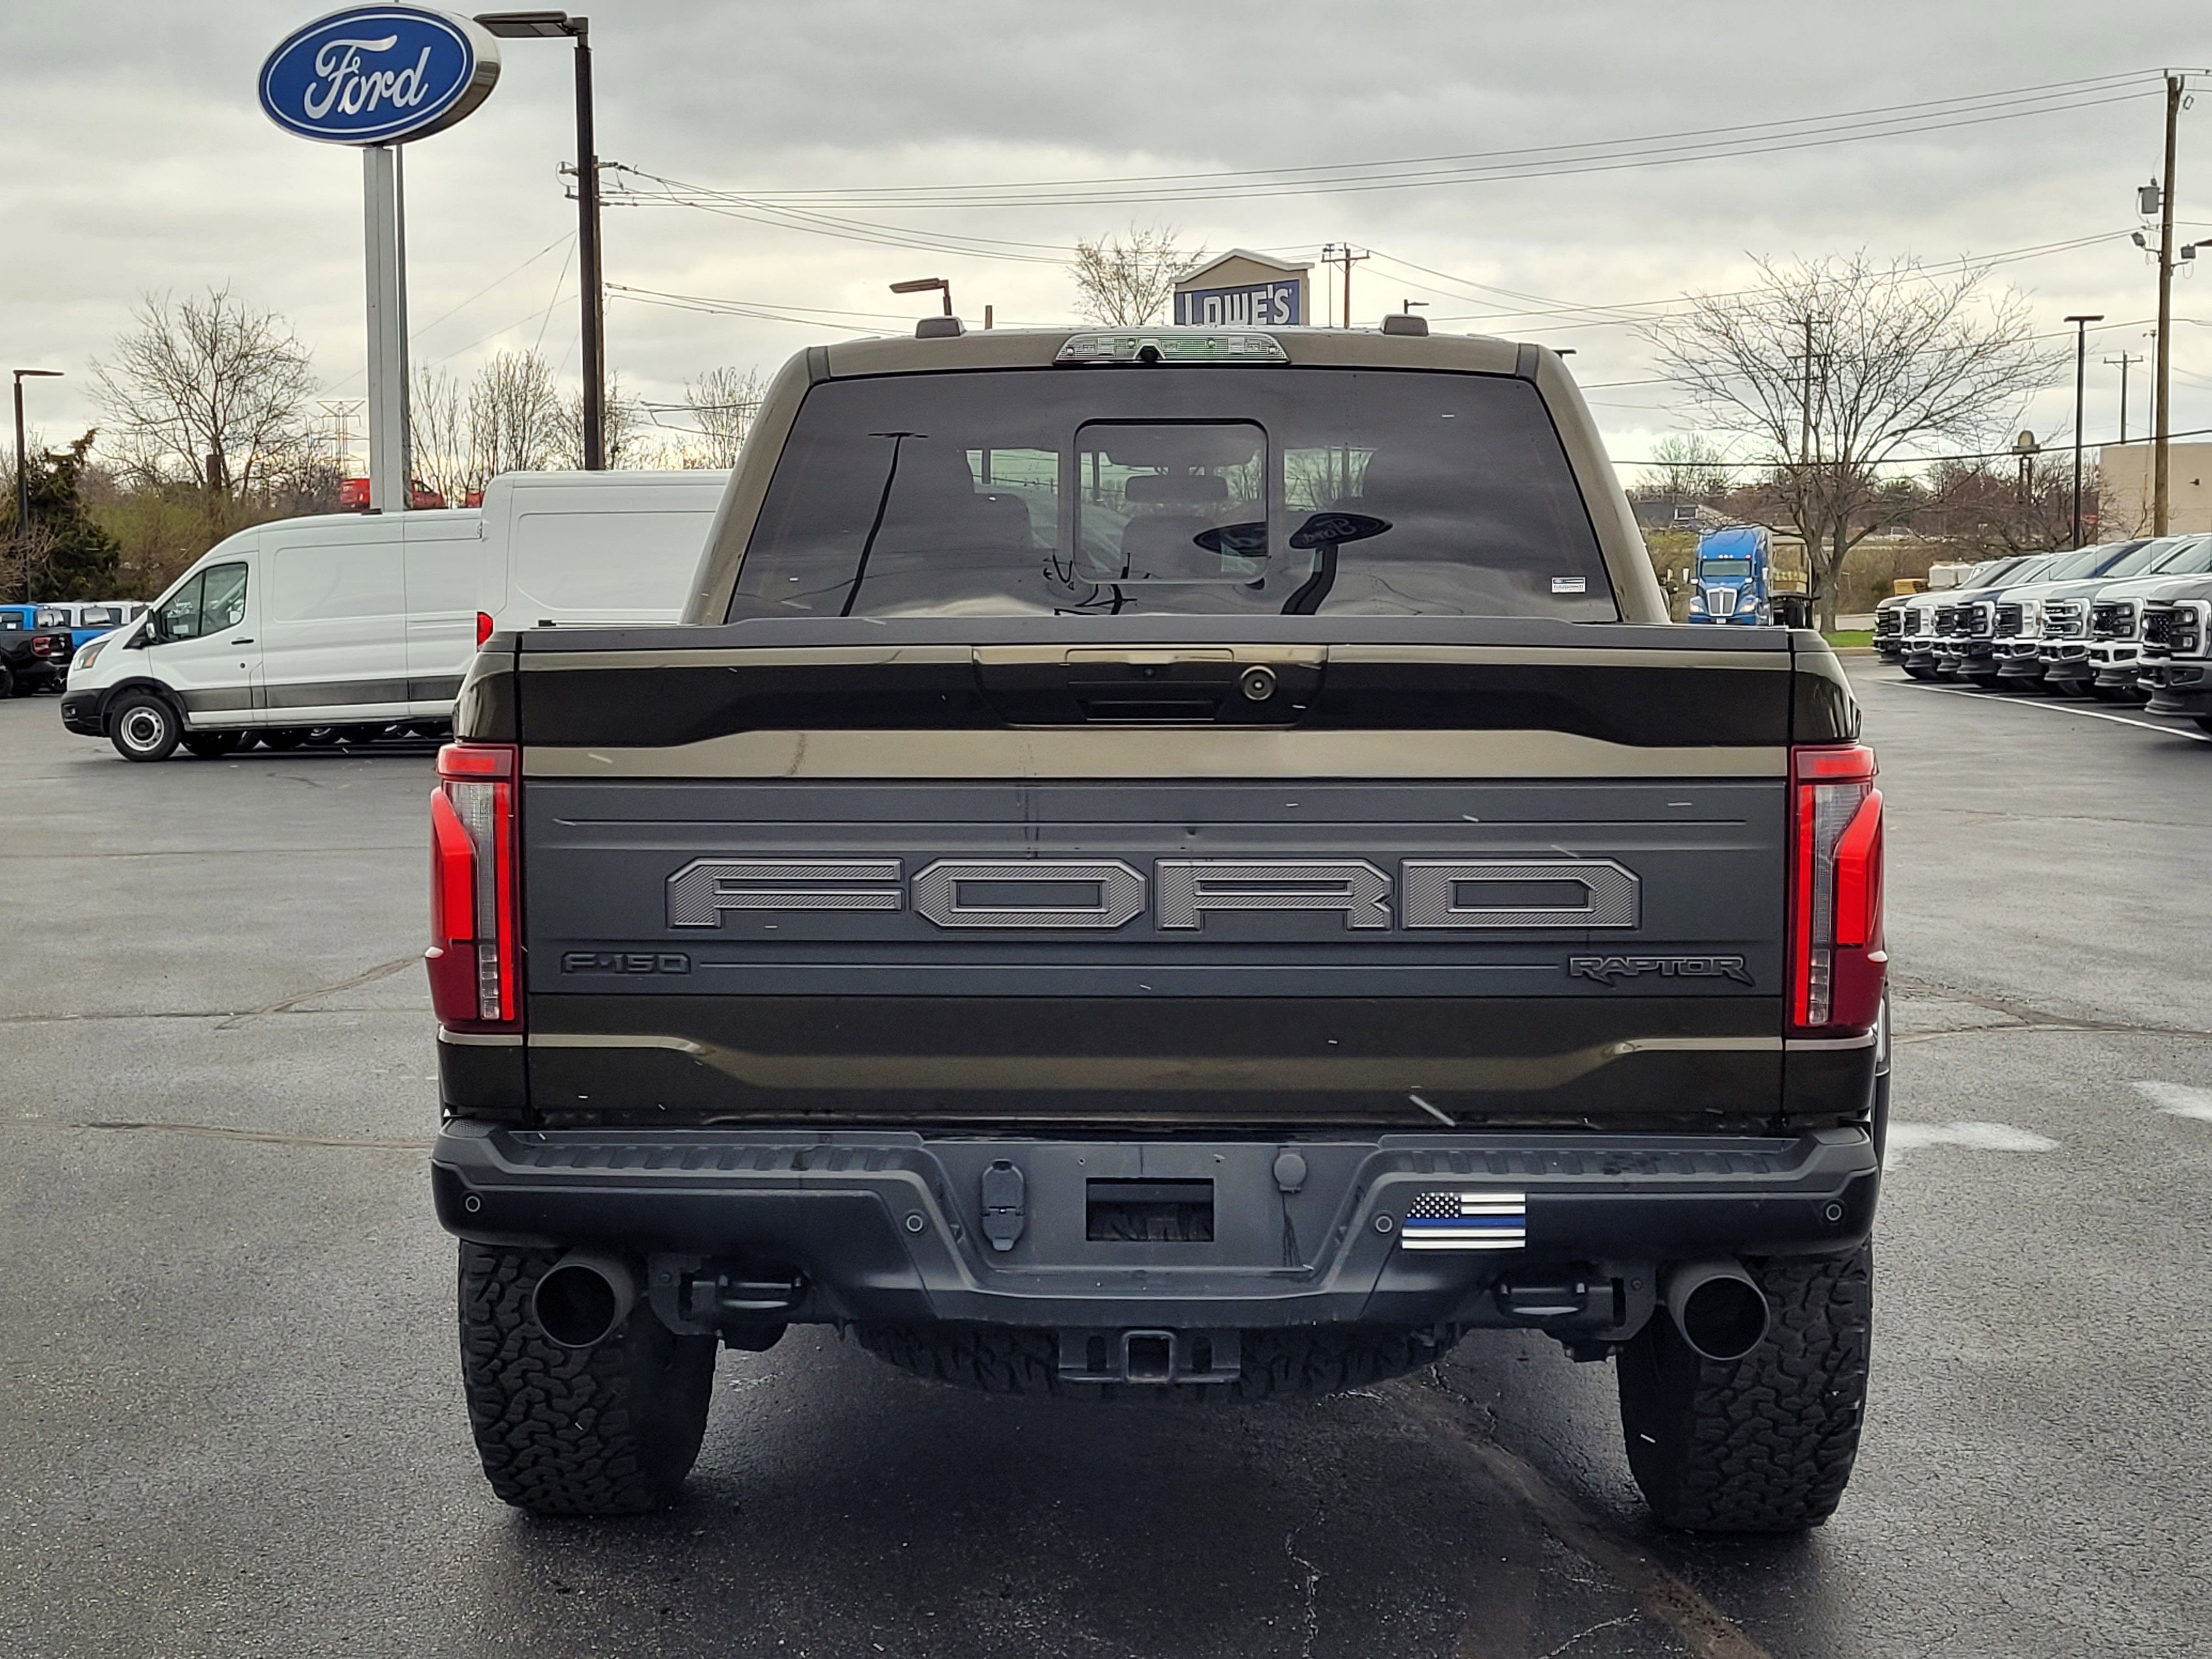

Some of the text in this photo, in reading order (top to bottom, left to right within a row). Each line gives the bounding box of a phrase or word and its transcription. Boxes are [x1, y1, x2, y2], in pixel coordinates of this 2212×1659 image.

[304, 35, 432, 120] Ford
[666, 857, 1642, 931] FORD
[563, 952, 690, 974] F-150
[1569, 955, 1755, 988] RAPTOR
